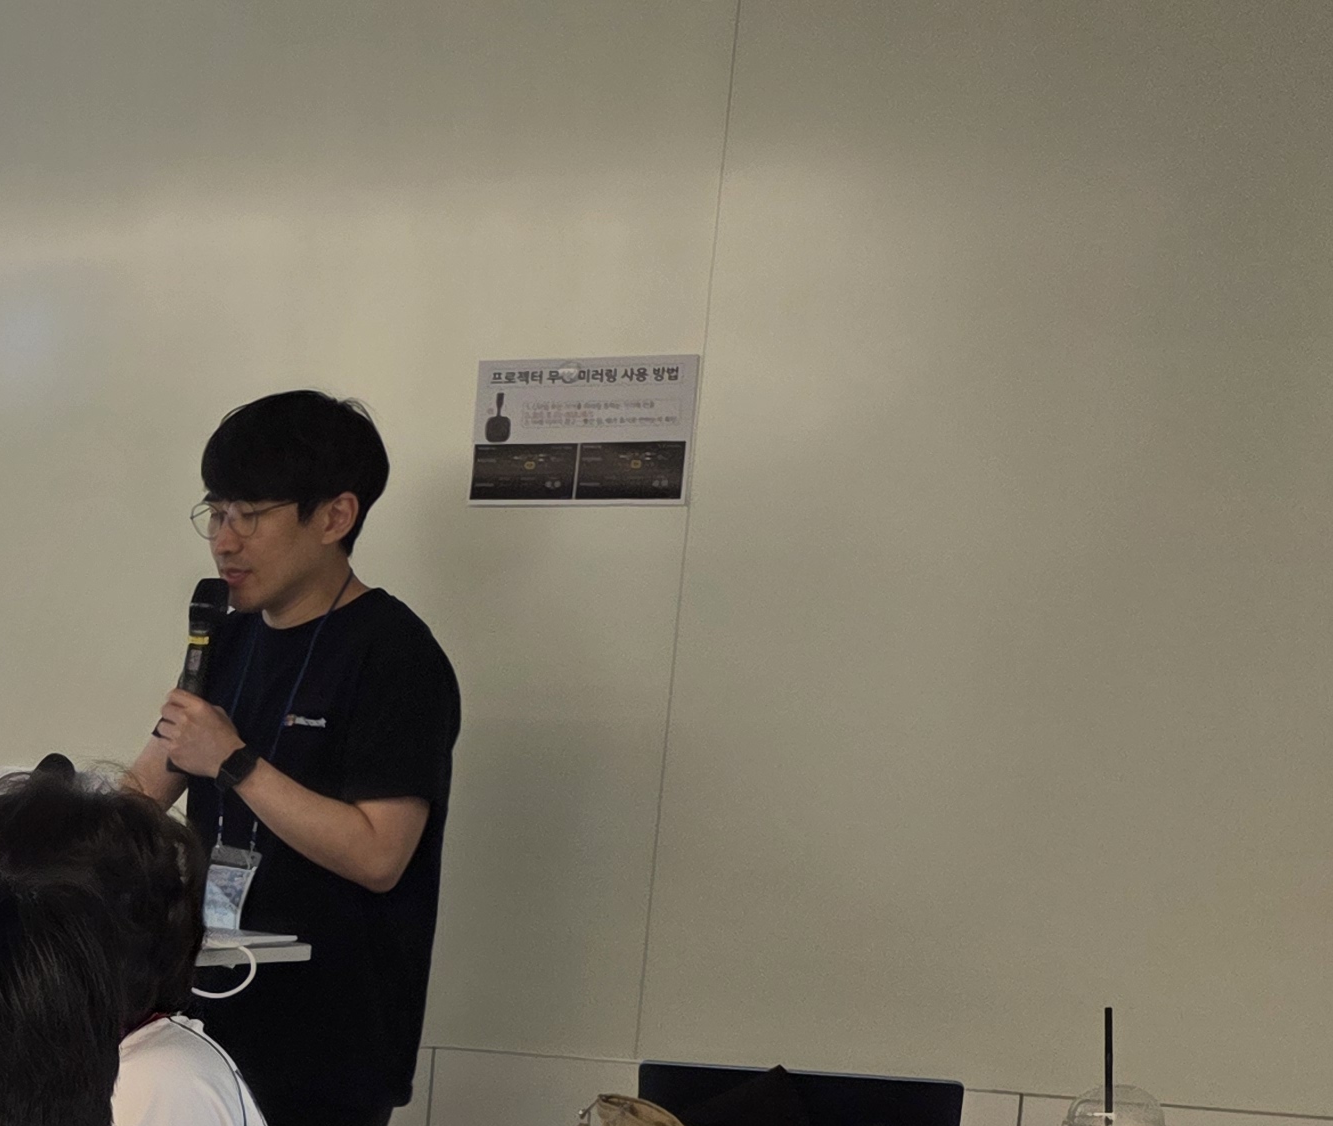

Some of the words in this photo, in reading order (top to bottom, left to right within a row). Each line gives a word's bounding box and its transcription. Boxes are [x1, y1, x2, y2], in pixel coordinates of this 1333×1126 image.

[490, 370, 544, 385] 프로젝터
[578, 368, 618, 384] 미러링
[621, 367, 649, 382] 사용
[652, 366, 680, 382] 방법
